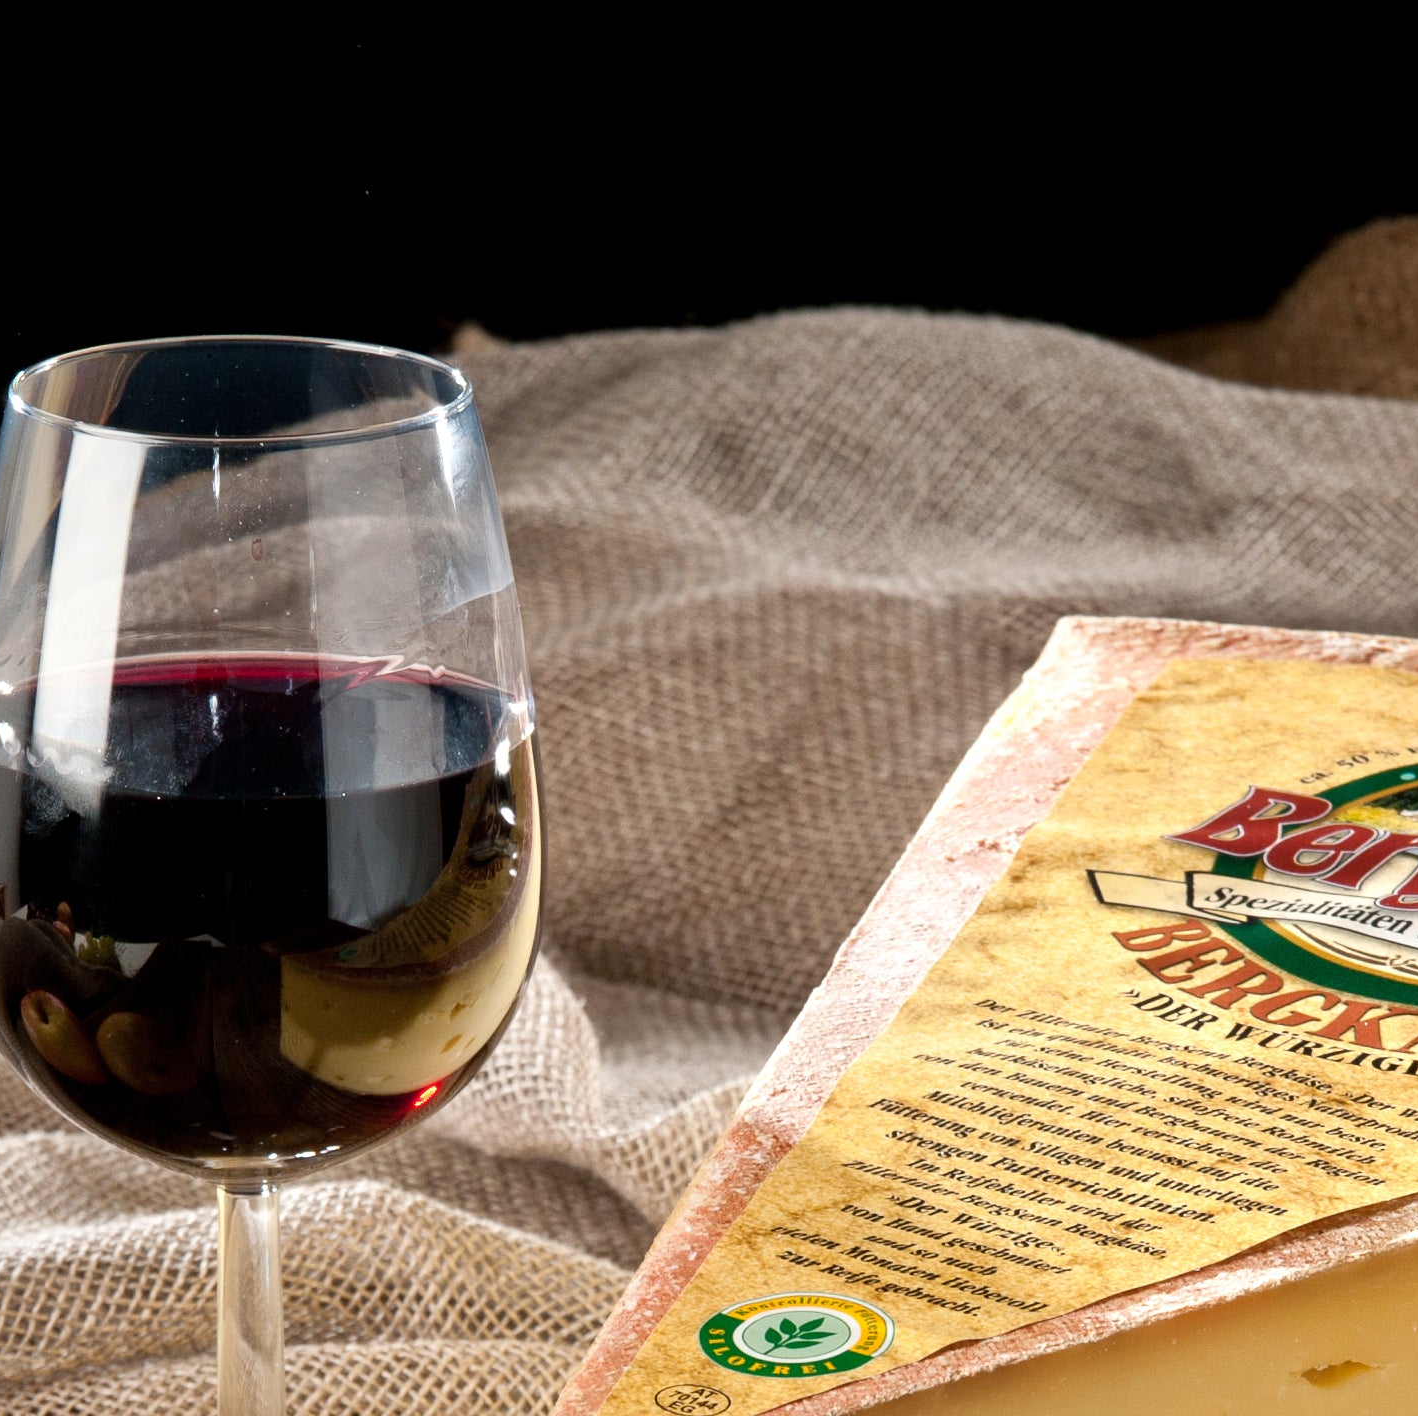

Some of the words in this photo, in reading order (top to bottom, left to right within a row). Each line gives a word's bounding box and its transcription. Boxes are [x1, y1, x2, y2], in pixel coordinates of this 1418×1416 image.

[1337, 754, 1370, 769] 50
[1203, 885, 1415, 936] Spezialitäten
[973, 999, 1016, 1014] Der
[1015, 1009, 1130, 1039] Zillertaler
[1231, 1055, 1333, 1095] Bergkäse,
[976, 1018, 1010, 1031] ist
[1008, 1026, 1046, 1038] ein
[1046, 1033, 1158, 1060] qualitativ
[1158, 1056, 1300, 1102] hochwertiges
[912, 1053, 957, 1066] von
[957, 1062, 1004, 1077] den
[1003, 1071, 1087, 1097] Bauern
[1086, 1092, 1139, 1111] und
[1133, 1104, 1265, 1149] Bergbauern
[1264, 1145, 1306, 1163] der
[1304, 1157, 1388, 1187] Region
[960, 1080, 1076, 1116] verwendet.
[1077, 1109, 1133, 1128] Hier
[1131, 1125, 1249, 1164] verzichten
[1248, 1158, 1289, 1175] die
[965, 1047, 1158, 1100] hartkäsetaugliche,
[1163, 1095, 1261, 1130] silofreie
[1260, 1126, 1378, 1166] Rohmilch
[1033, 1046, 1095, 1063] seine
[1094, 1058, 1224, 1100] Herstellung
[1224, 1095, 1284, 1116] wird
[1279, 1111, 1325, 1129] nur
[1326, 1125, 1386, 1152] beste,
[868, 1098, 977, 1140] Fütterung
[978, 1130, 1022, 1149] von
[1021, 1140, 1107, 1172] Silagen
[1107, 1164, 1161, 1184] und
[1156, 1175, 1290, 1217] unterliegen
[885, 1128, 989, 1164] strengen
[988, 1155, 1217, 1224] Futterrichtlinien.
[921, 1090, 1106, 1146] Milchlieferanten
[1104, 1137, 1199, 1170] bewusst
[1197, 1164, 1248, 1184] auf
[1239, 1175, 1281, 1193] die
[840, 1159, 962, 1197] Zillertaler
[959, 1193, 1064, 1228] BergSenn
[1062, 1222, 1168, 1260] Bergkäse,
[885, 1193, 950, 1218] »Der
[950, 1212, 1067, 1257] Würzige«,
[906, 1157, 940, 1174] Im
[941, 1166, 1067, 1208] Reifekeller
[1064, 1201, 1126, 1223] wird
[1118, 1216, 1164, 1234] der
[769, 1225, 841, 1249] vielen
[839, 1245, 942, 1282] Monaten
[940, 1275, 1050, 1314] liebevoll
[840, 1203, 886, 1223] von
[884, 1216, 952, 1241] Hand
[941, 1235, 1073, 1275] geschmiert
[863, 1233, 914, 1252] und
[909, 1246, 941, 1260] so
[939, 1254, 998, 1277] nach
[734, 1296, 855, 1317] Kontrollierte
[776, 1249, 822, 1268] zur
[819, 1262, 883, 1288] Reife
[877, 1281, 979, 1318] gebracht.
[708, 1326, 838, 1376] SILOFREI
[667, 1400, 697, 1413] EG
[668, 1390, 719, 1410] 70144
[690, 1388, 719, 1399] AT
